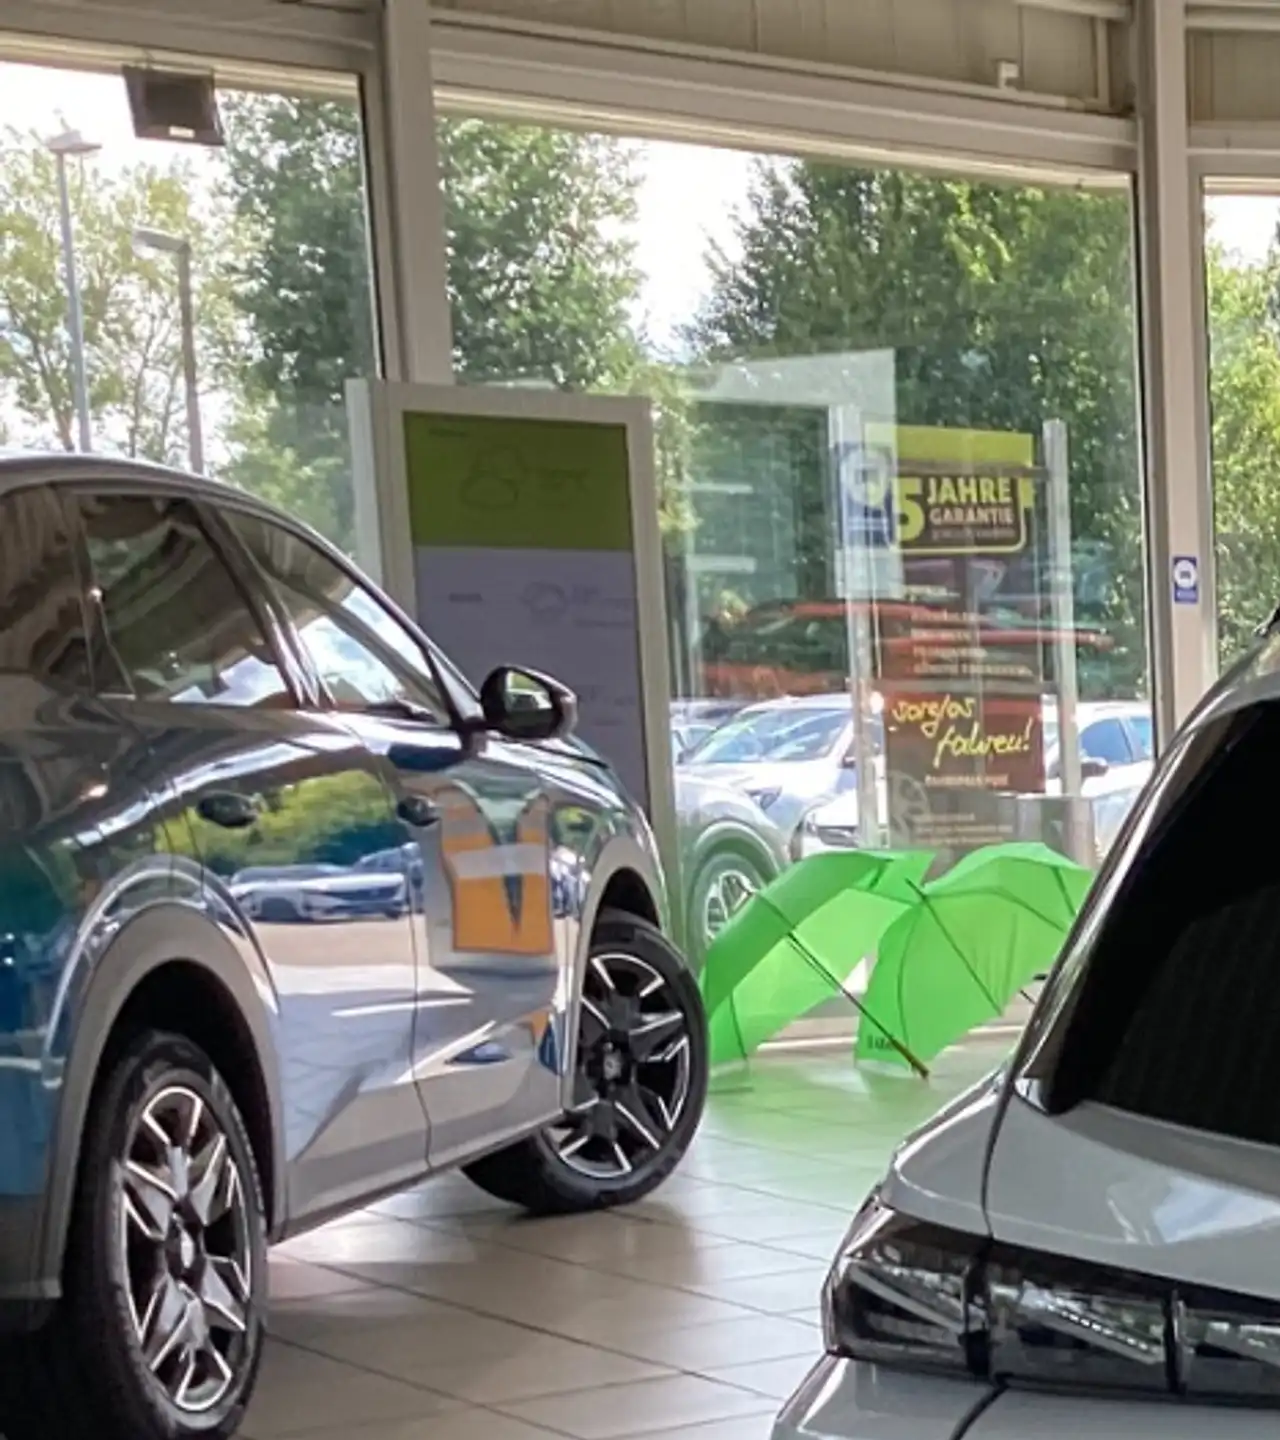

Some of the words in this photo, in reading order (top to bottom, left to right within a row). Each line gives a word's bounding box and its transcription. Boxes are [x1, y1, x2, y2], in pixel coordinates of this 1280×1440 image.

[893, 476, 926, 541] 5
[927, 476, 1013, 505] JAHRE
[929, 507, 1014, 526] GARANTIE
